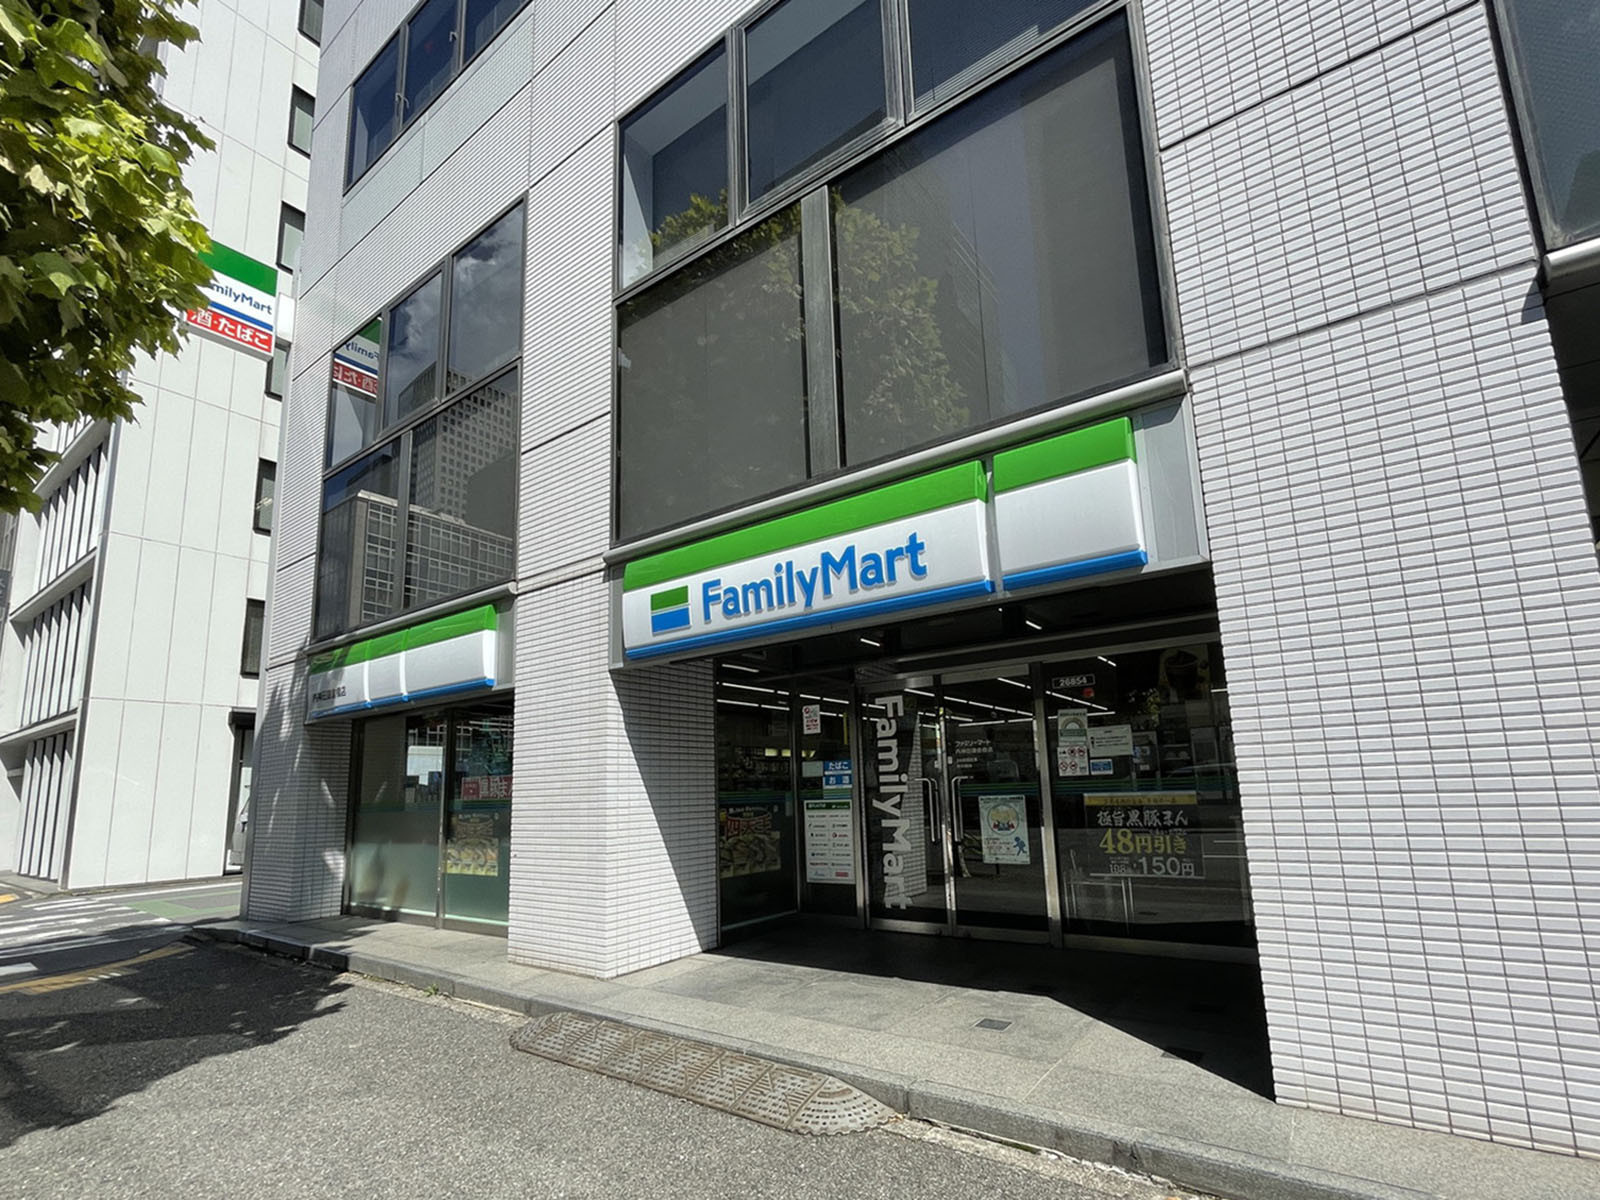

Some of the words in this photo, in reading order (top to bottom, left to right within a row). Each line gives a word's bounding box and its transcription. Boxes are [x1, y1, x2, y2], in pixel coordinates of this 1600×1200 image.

[212, 284, 272, 315] milyMart
[702, 532, 928, 623] FamilyMart
[828, 762, 849, 771] たばこ
[872, 695, 914, 910] FamilyMart
[1096, 809, 1189, 827] 極旨黒豚まん
[1098, 828, 1187, 855] 48円引き
[1138, 856, 1195, 877] 150円
